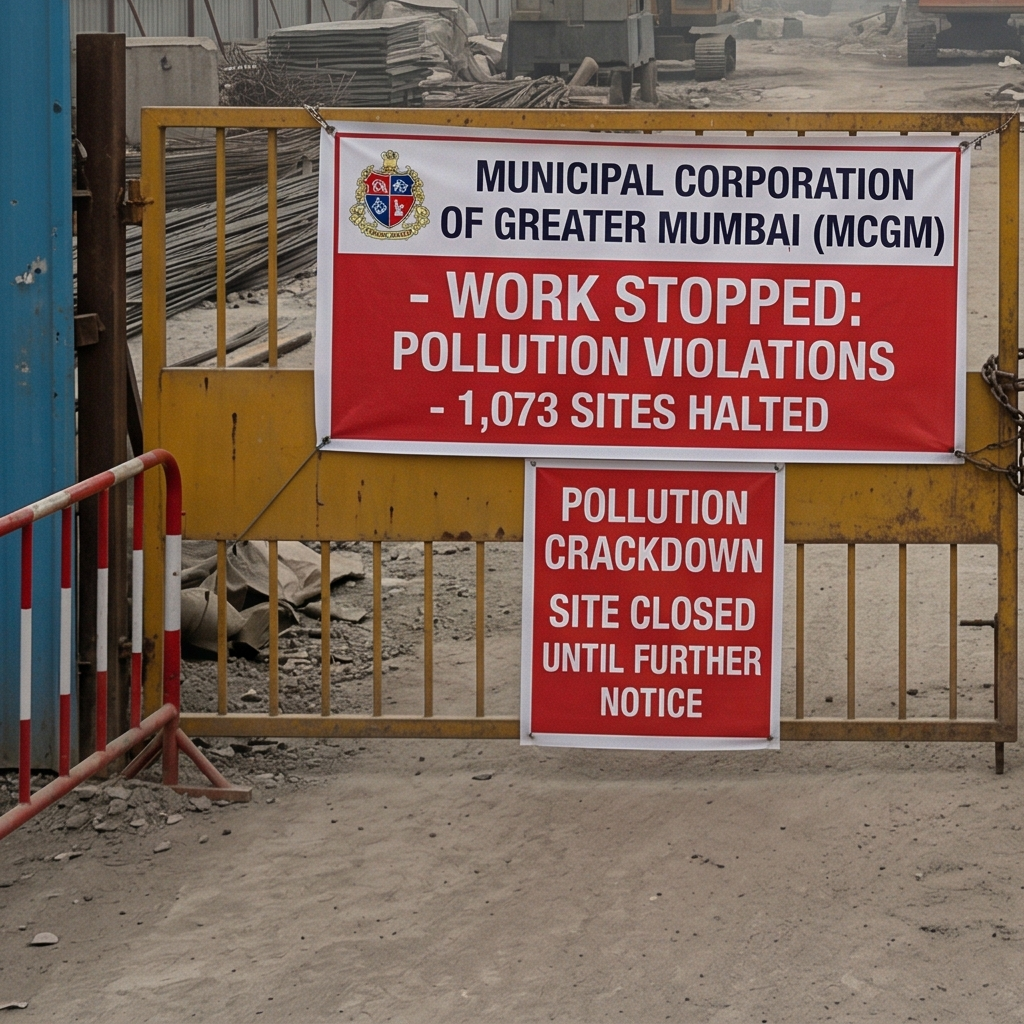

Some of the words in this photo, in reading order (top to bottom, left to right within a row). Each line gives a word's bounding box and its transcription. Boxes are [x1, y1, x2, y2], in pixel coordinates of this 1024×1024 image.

[476, 159, 664, 197] MUNICIPAL
[675, 164, 914, 201] CORPORATION
[440, 205, 484, 239] OF
[494, 207, 647, 244] GREATER
[658, 210, 800, 247] MUMBAI
[813, 214, 945, 257] (MCGM)
[409, 293, 429, 303] -
[446, 270, 601, 322] WORK
[614, 274, 861, 327] STOPPED:
[393, 330, 629, 377] POLLUTION
[643, 336, 895, 382] VIOLATIONS
[429, 406, 445, 414] -
[458, 389, 559, 434] 1,073
[570, 391, 676, 430] SITES
[688, 394, 829, 433] HALTED
[562, 486, 748, 526] POLLUTION
[544, 533, 763, 573] CRACKDOWN
[549, 593, 620, 629] SITE
[630, 595, 756, 631] CLOSED
[542, 641, 625, 674] UNTIL
[634, 644, 762, 676] FURTHER
[600, 686, 703, 718] NOTICE
